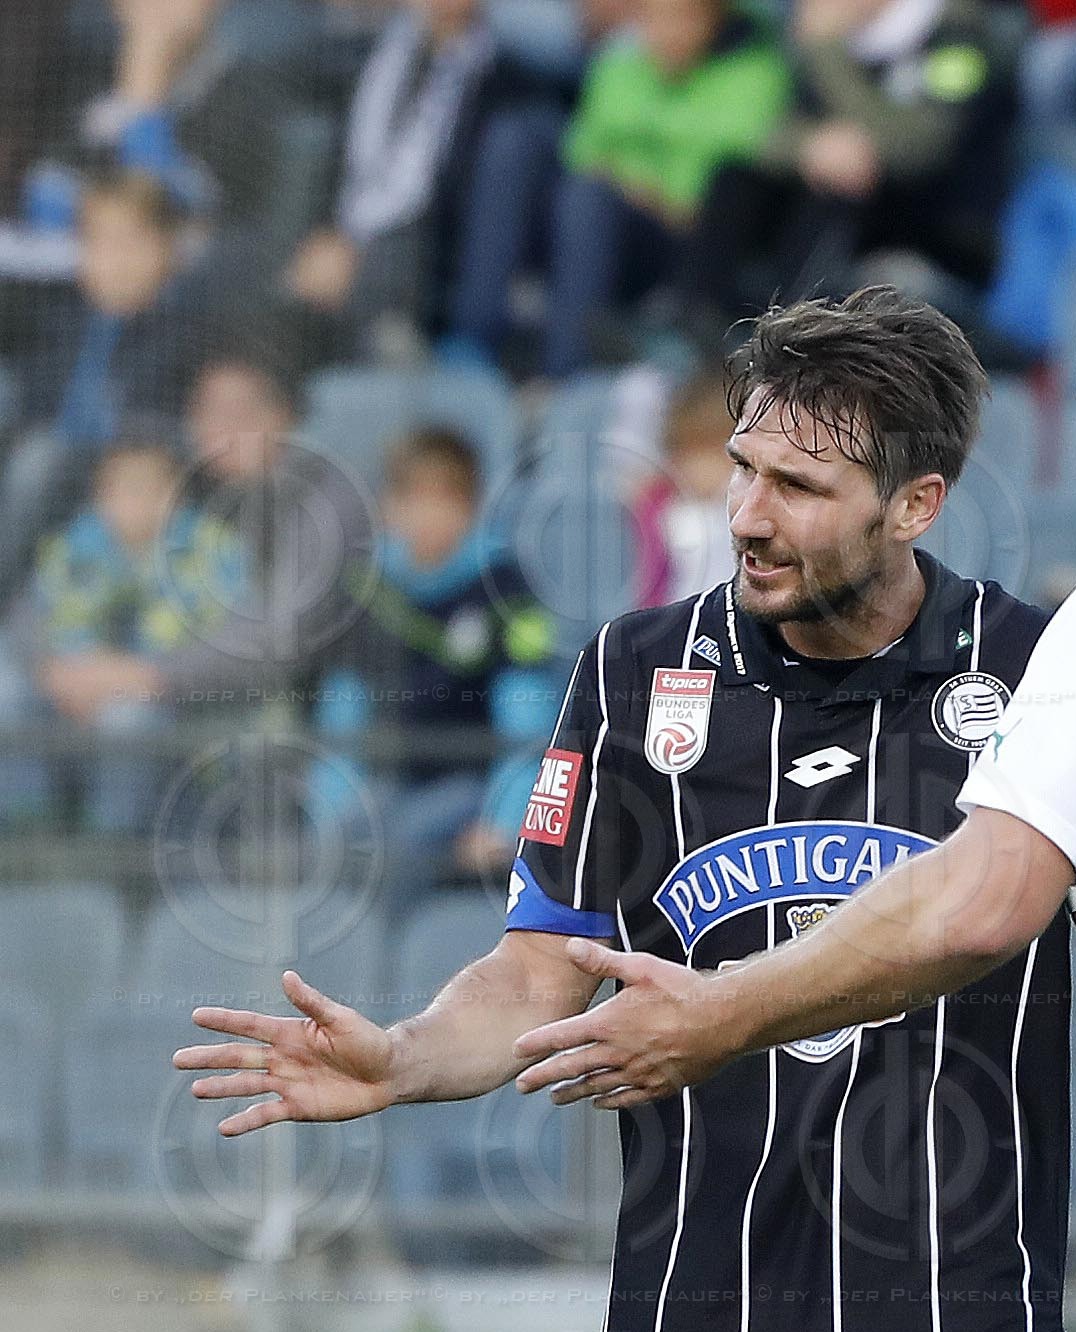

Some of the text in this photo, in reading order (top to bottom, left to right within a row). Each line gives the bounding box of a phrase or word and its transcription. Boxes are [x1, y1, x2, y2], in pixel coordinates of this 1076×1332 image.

[661, 674, 708, 690] tipico
[656, 699, 706, 710] BUNDES
[666, 710, 694, 719] LIGA
